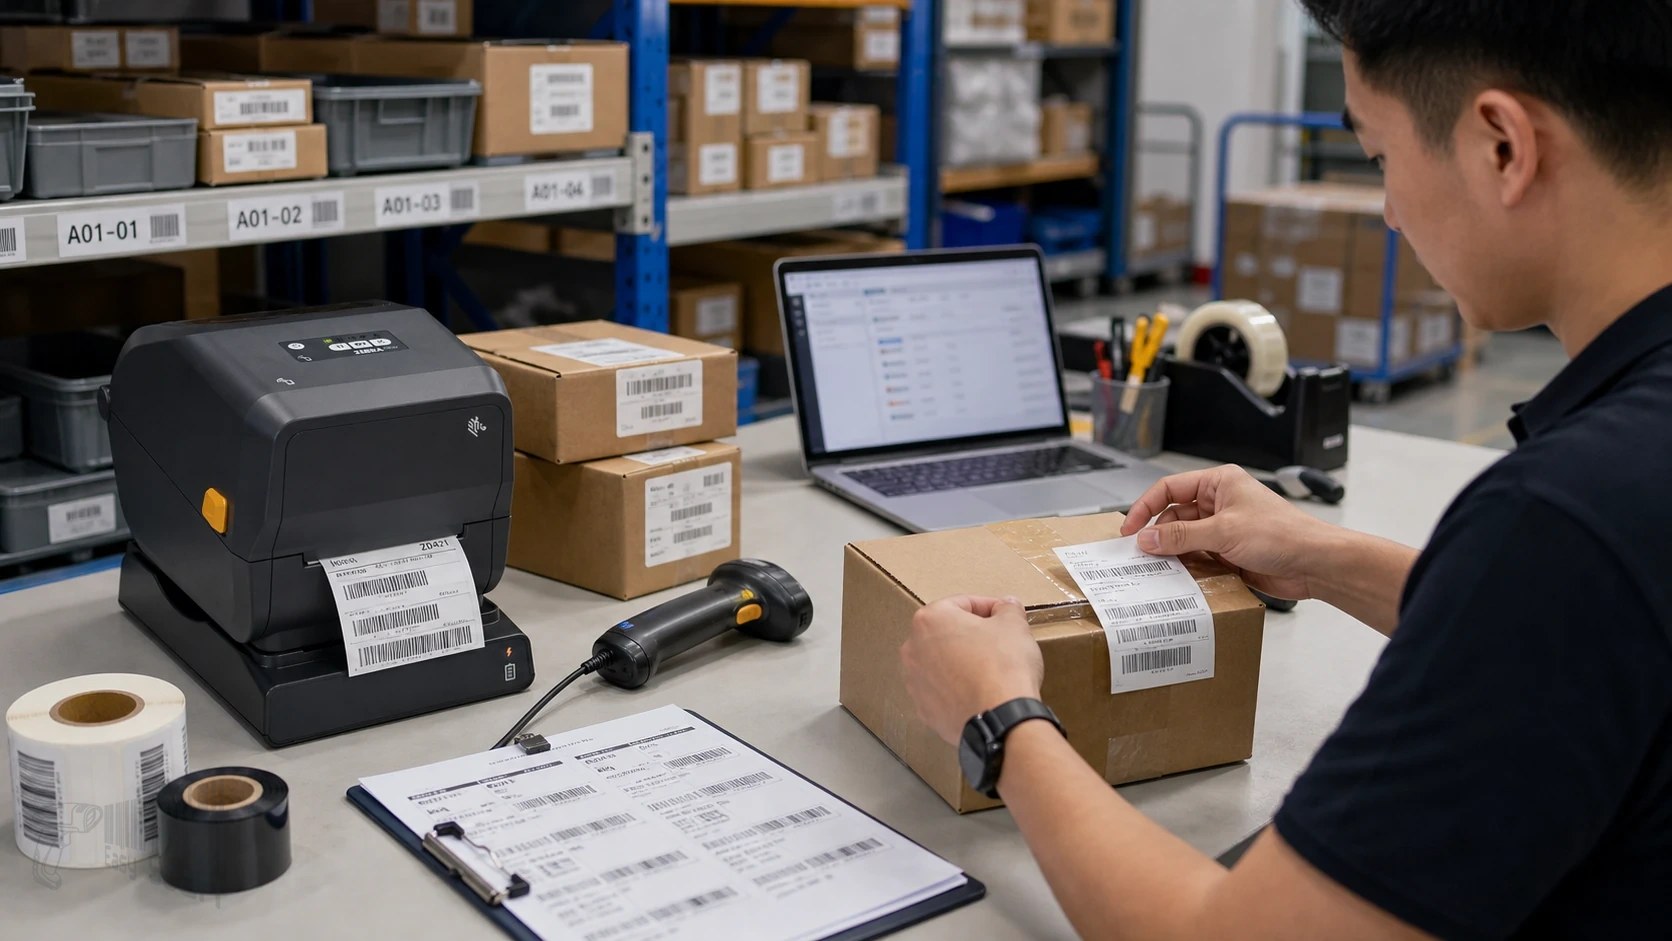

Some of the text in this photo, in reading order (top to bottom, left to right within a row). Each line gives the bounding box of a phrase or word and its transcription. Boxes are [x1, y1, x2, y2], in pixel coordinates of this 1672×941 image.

[383, 194, 441, 215] A01-03
[236, 206, 302, 229] A01-02
[67, 220, 138, 244] A01-01
